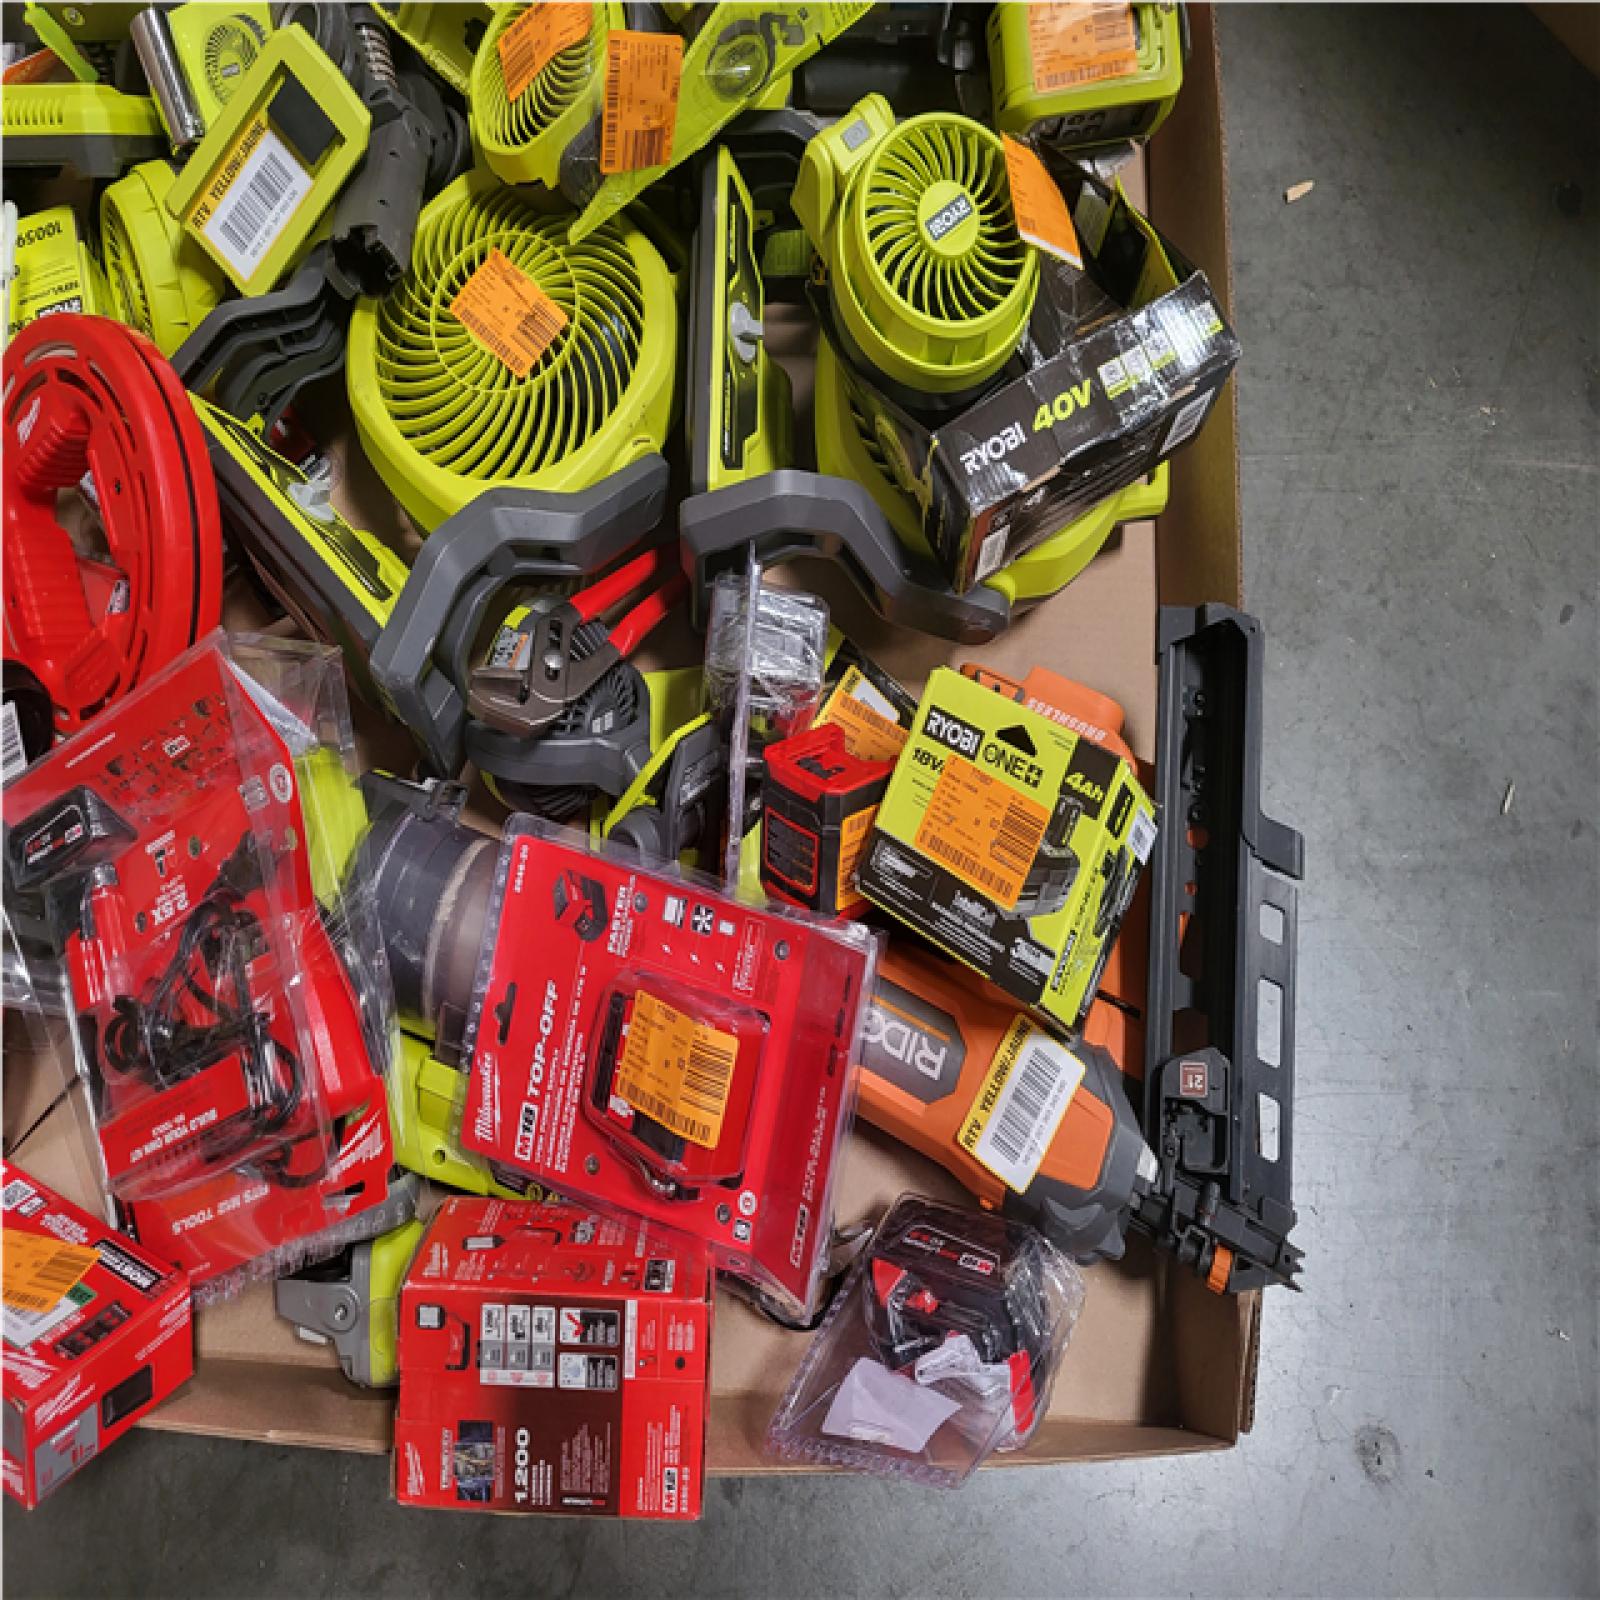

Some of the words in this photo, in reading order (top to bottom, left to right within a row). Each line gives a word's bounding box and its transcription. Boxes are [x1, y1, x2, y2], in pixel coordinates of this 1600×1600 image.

[191, 202, 211, 230] RTV
[929, 199, 971, 238] RYOBI
[1032, 377, 1091, 433] 40V
[960, 421, 1027, 475] RYOBI
[926, 709, 981, 756] RYOBI
[516, 1104, 537, 1160] M18
[527, 980, 559, 1097] TOP-OFF
[964, 1119, 982, 1148] RTV
